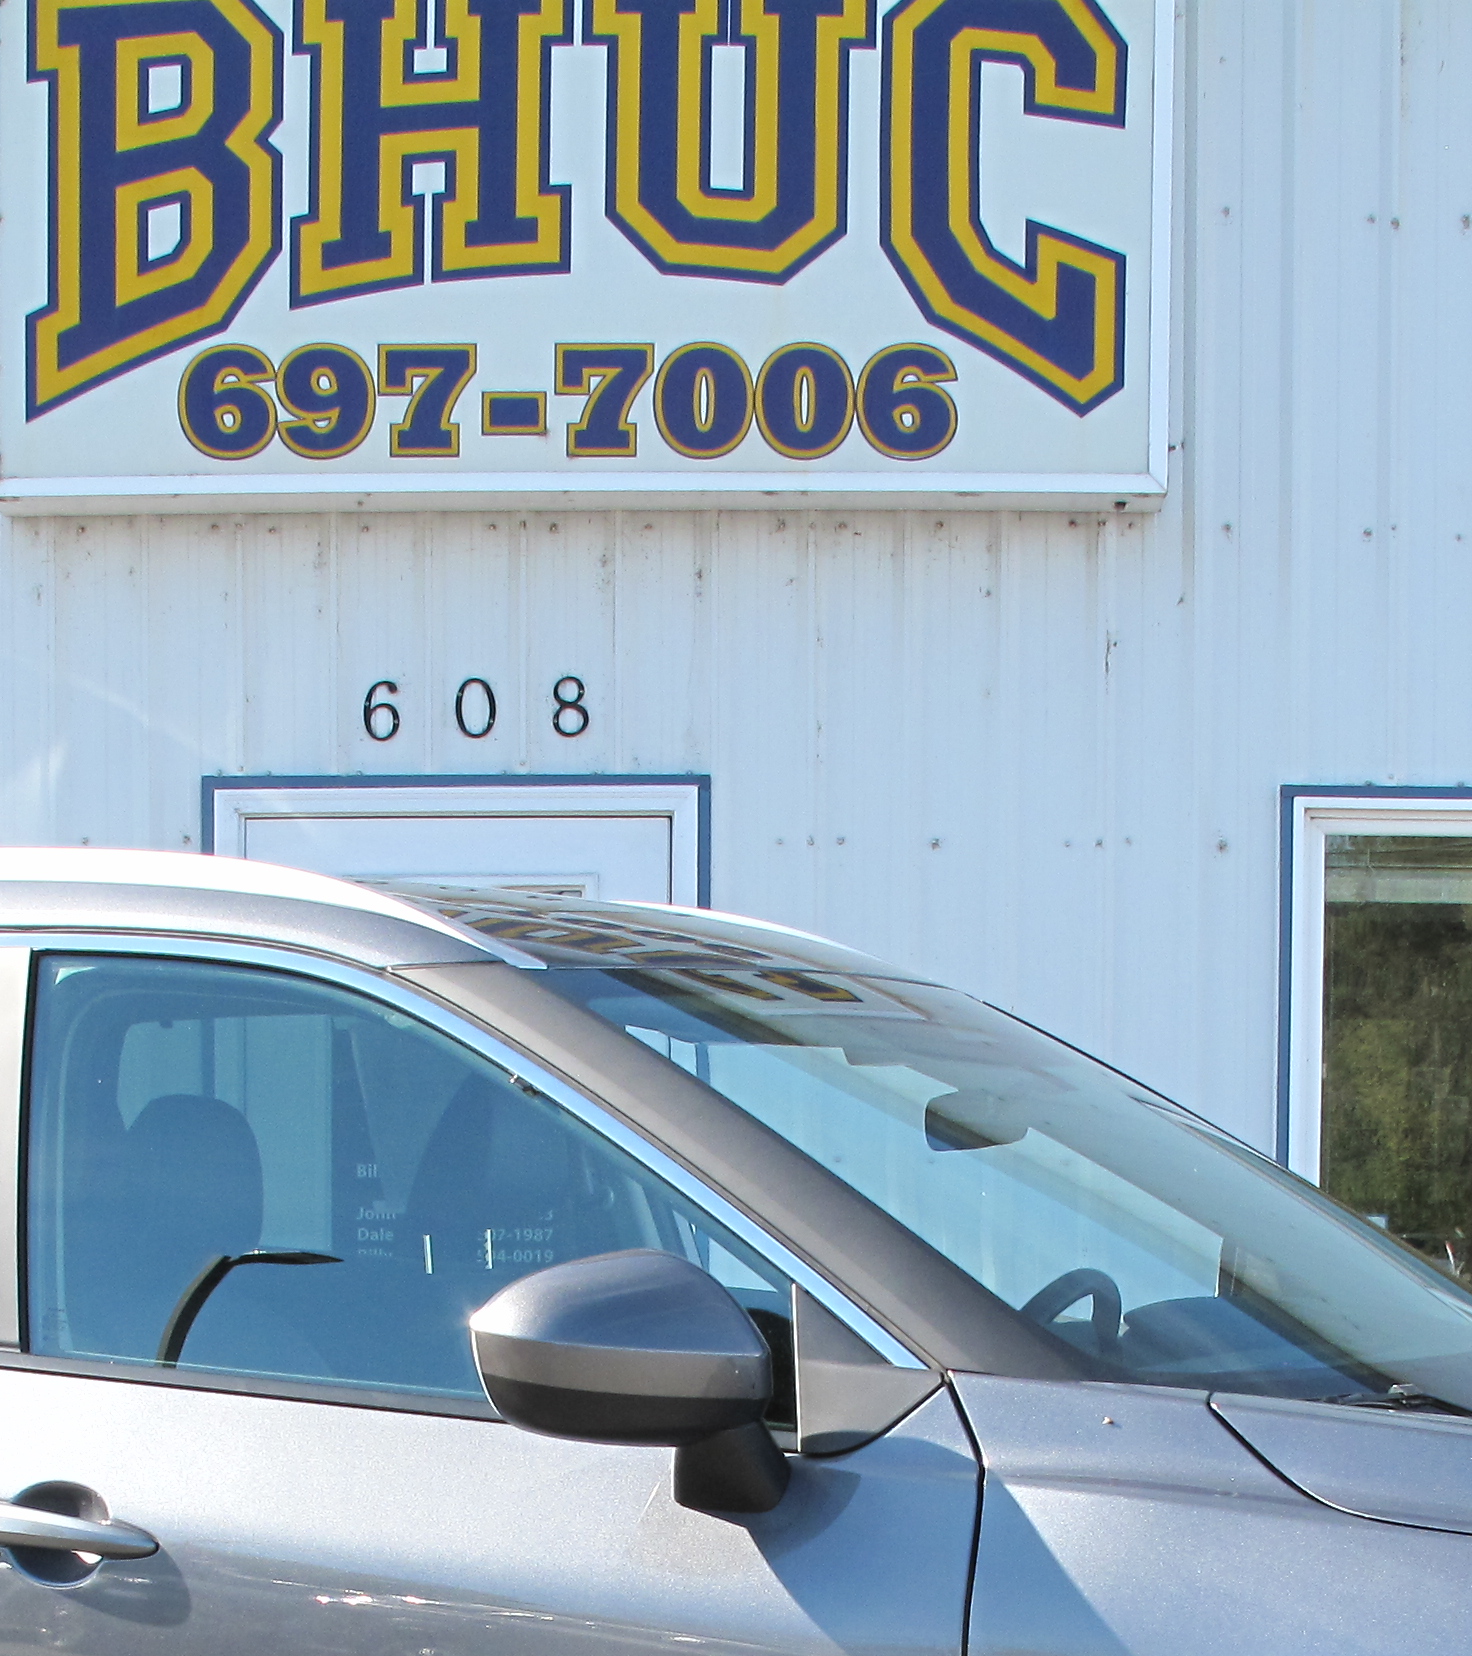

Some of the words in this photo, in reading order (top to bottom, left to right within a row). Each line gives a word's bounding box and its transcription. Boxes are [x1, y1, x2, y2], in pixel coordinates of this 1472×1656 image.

[25, 0, 1128, 422] BHUC
[177, 341, 959, 461] 697-7006
[363, 675, 592, 743] 608
[358, 1227, 394, 1241] Dale
[477, 1229, 553, 1241] 7-1987
[476, 1249, 553, 1263] 54-0019
